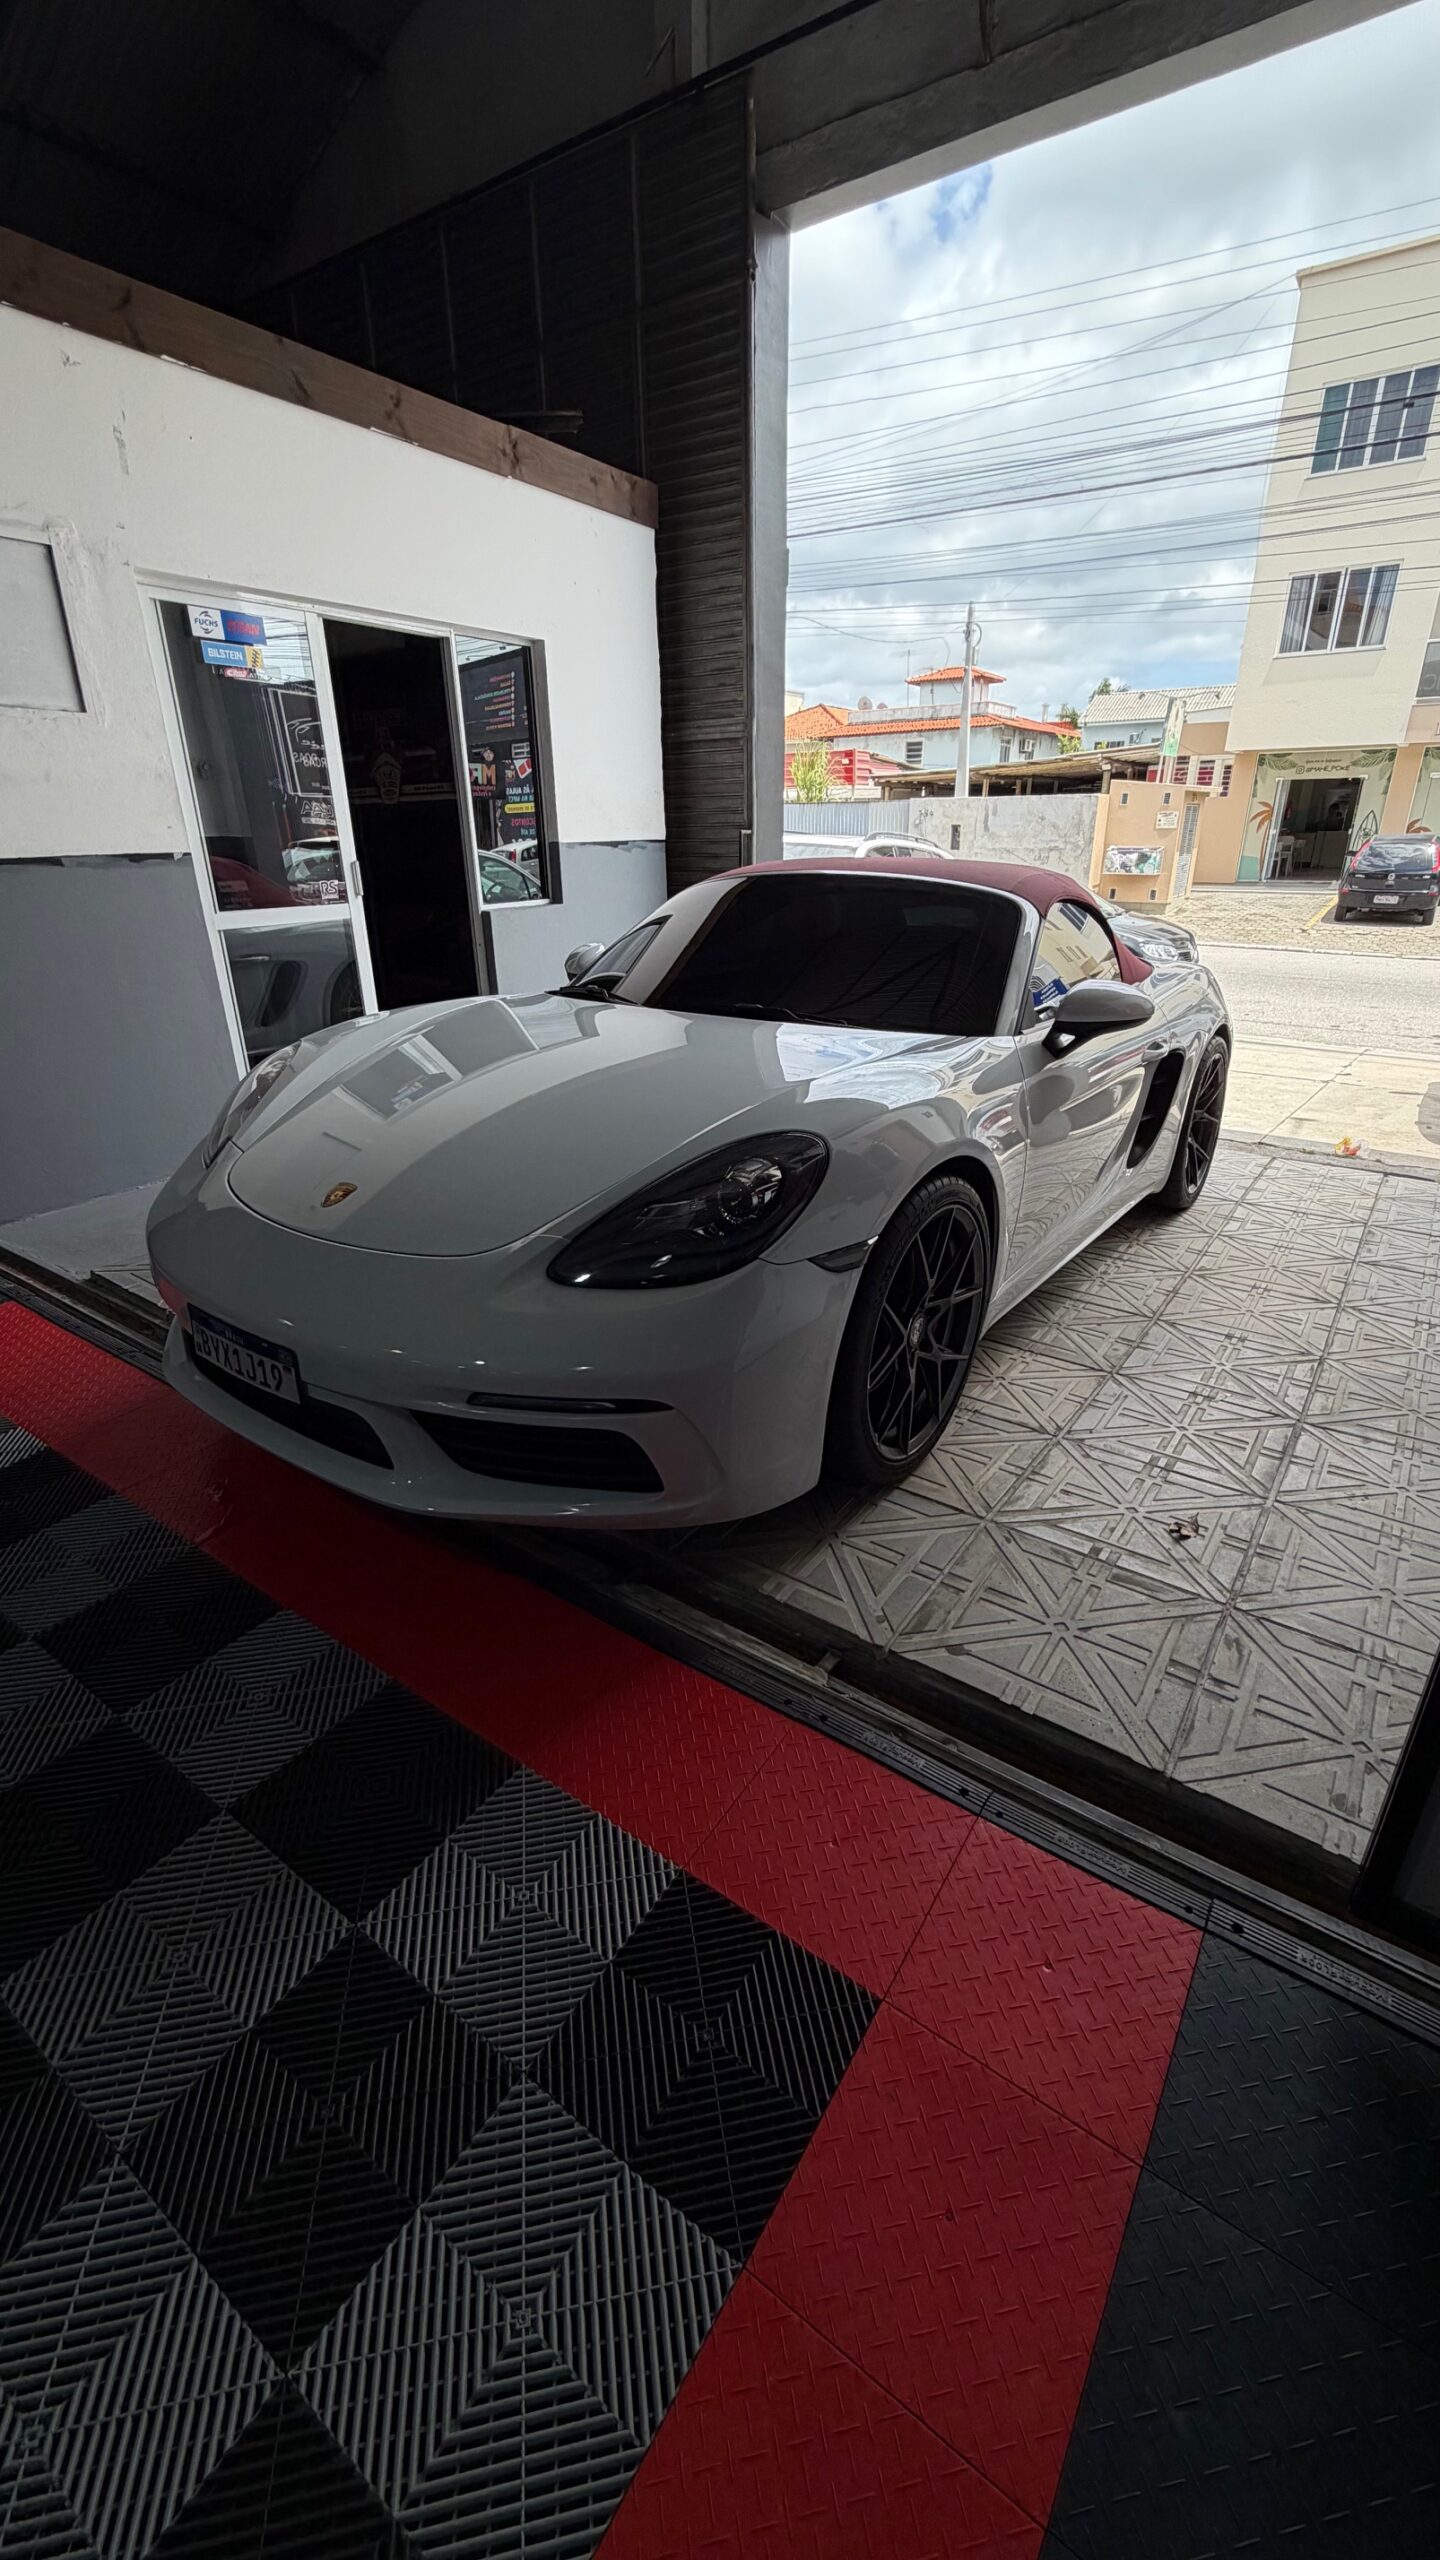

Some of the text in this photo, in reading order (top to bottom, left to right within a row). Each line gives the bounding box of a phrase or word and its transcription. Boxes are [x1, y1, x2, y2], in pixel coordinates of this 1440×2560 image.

[195, 617, 218, 628] FUCHS
[207, 647, 244, 661] BILSTEIN
[320, 880, 338, 895] RS
[200, 1327, 283, 1392] BYX1J19
